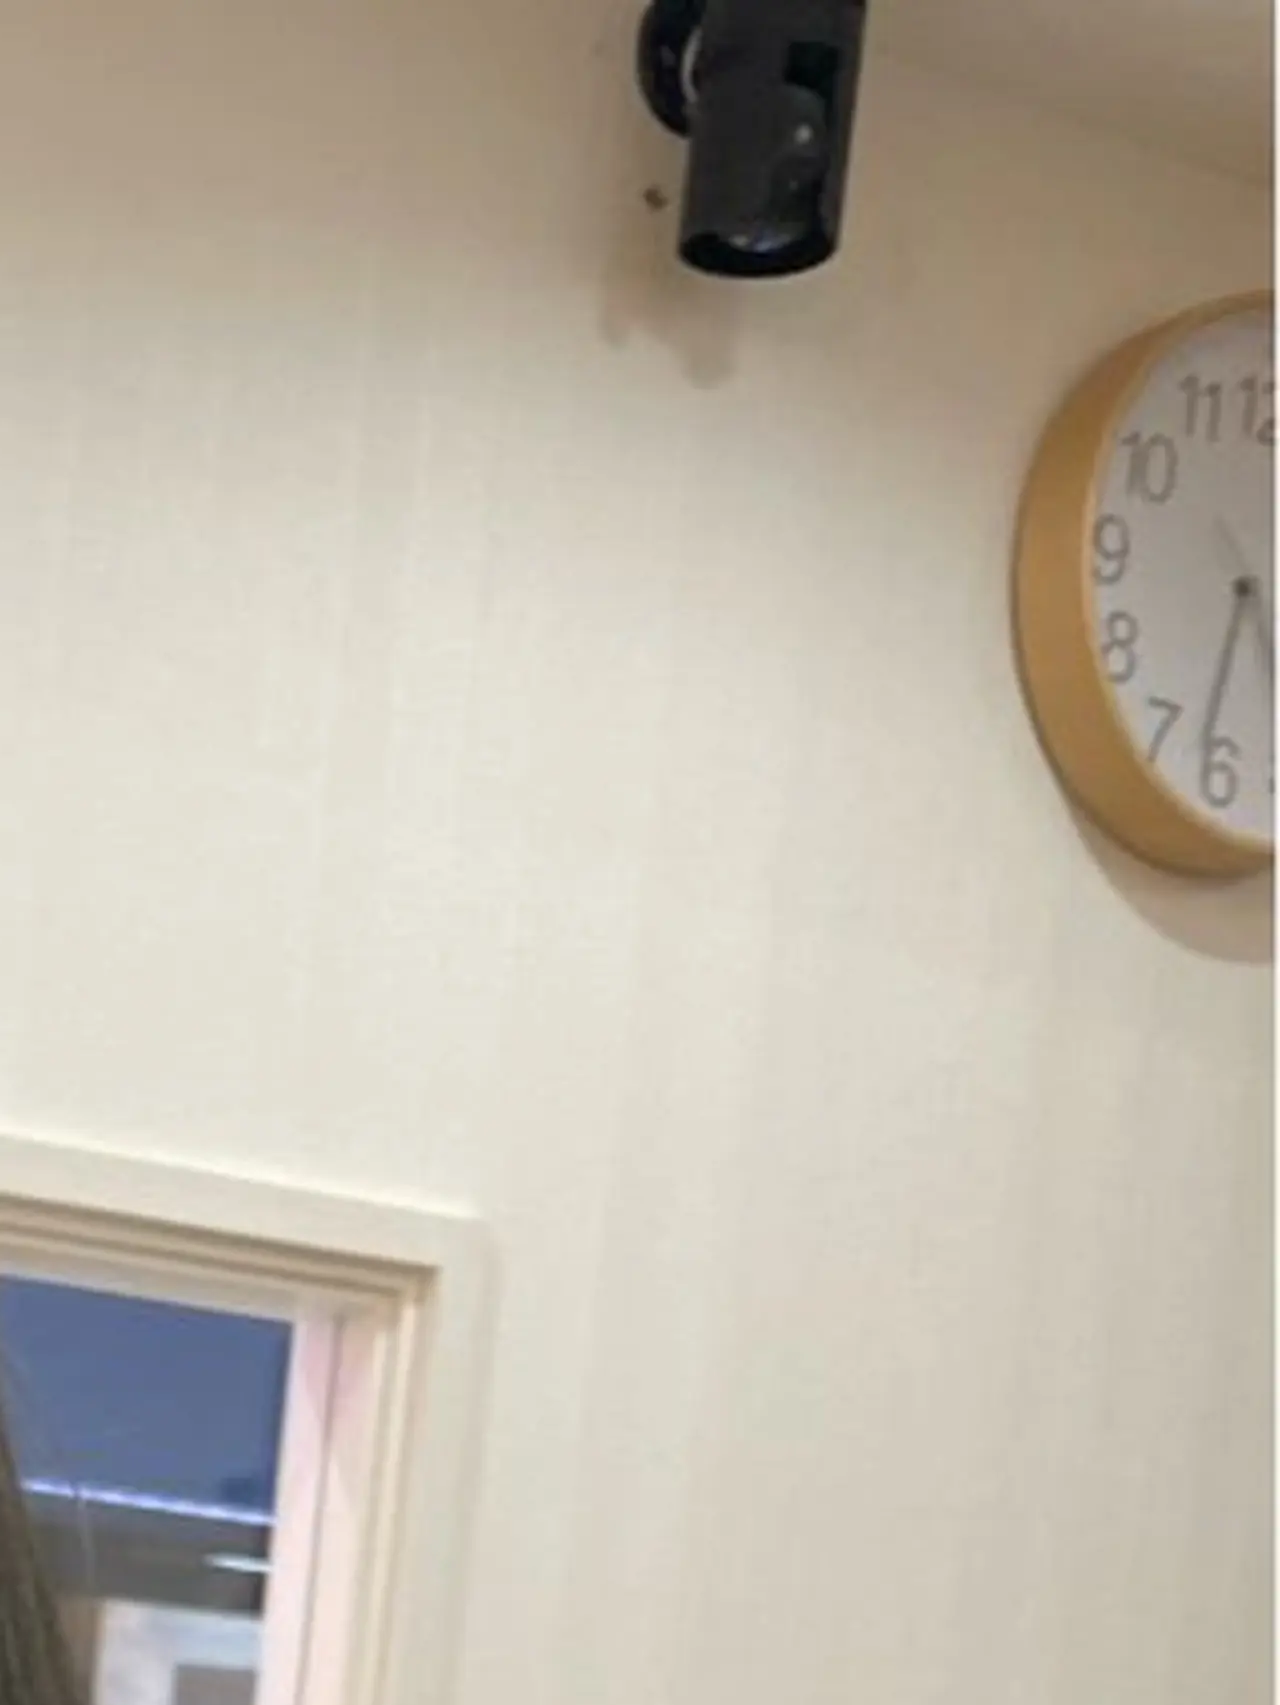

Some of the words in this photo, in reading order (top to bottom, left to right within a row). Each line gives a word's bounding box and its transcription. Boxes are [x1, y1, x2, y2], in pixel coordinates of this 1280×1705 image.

[1178, 374, 1221, 442] 11
[1121, 431, 1178, 504] 10
[1093, 512, 1130, 581] 9
[1102, 609, 1138, 683] 8
[1148, 696, 1182, 763] 7
[1201, 735, 1241, 808] 6
